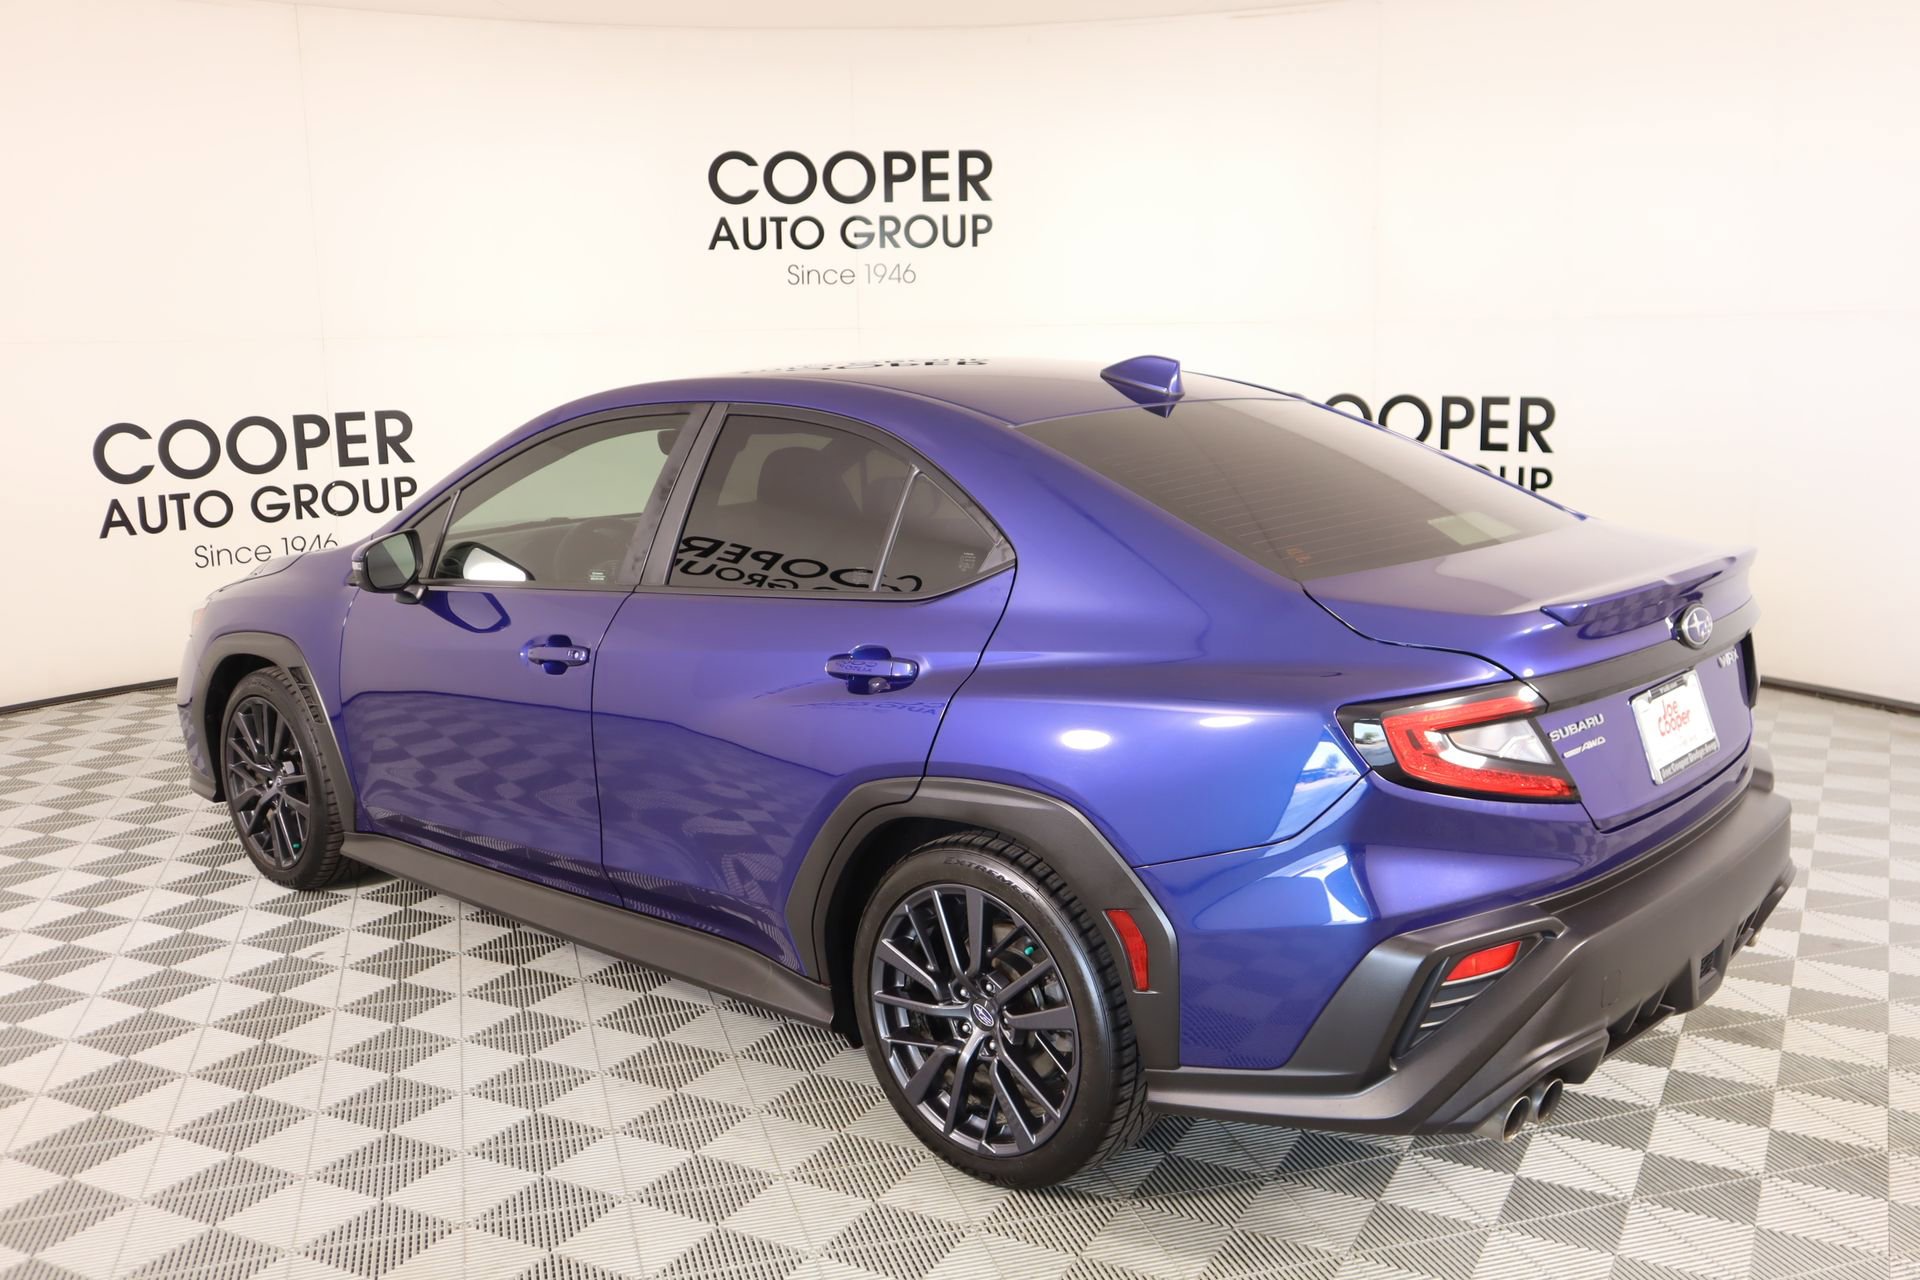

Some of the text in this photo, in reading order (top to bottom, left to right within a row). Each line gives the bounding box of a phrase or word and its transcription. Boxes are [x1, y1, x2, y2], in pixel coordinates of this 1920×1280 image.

[708, 149, 993, 205] COOPER
[708, 213, 993, 250] AUTO GROUP
[787, 262, 917, 286] Since 1946
[93, 409, 415, 485] COOPER
[99, 476, 417, 539] AUTO GROUP
[194, 543, 272, 569] Since
[1718, 648, 1739, 668] WRX
[1658, 709, 1690, 737] Cooper
[1661, 698, 1679, 720] Joe
[1549, 713, 1604, 742] SUBARU
[1581, 736, 1606, 752] AWD
